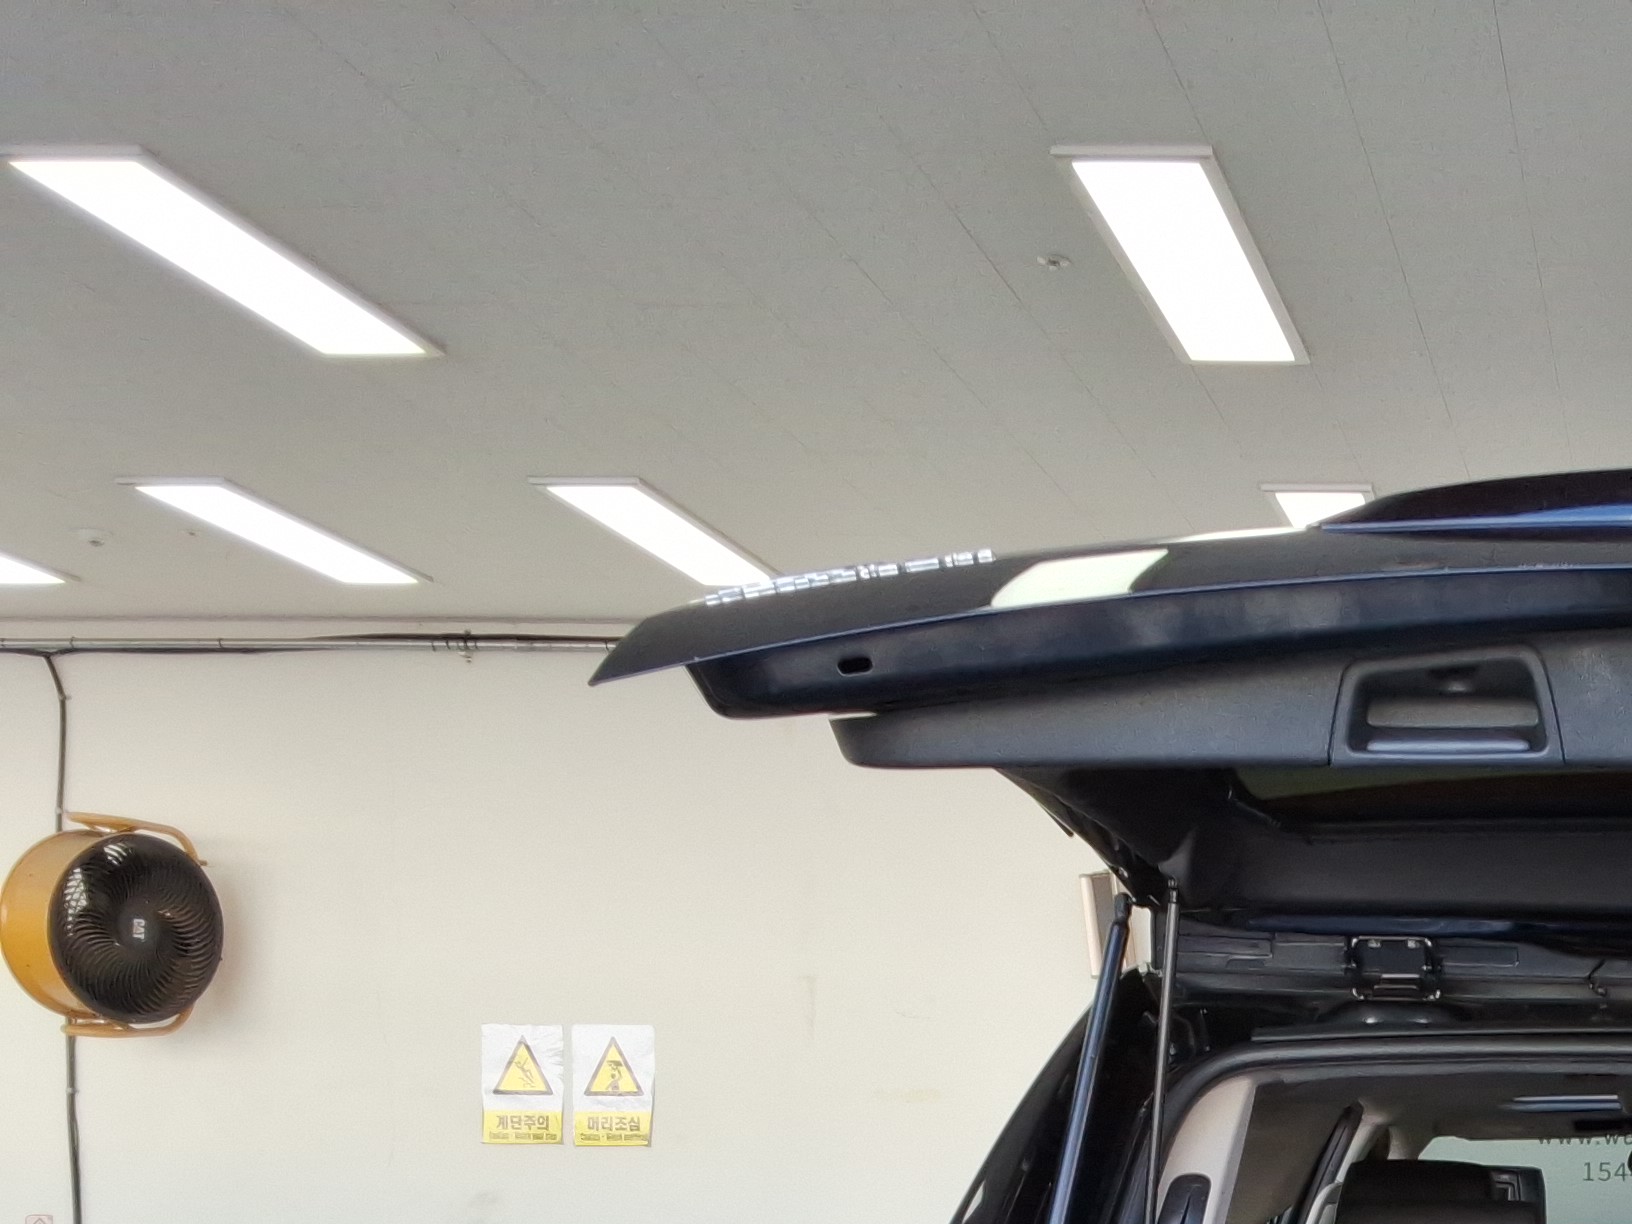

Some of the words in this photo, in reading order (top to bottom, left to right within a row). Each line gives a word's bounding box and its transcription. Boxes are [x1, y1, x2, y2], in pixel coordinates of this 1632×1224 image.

[133, 918, 145, 940] CAT
[496, 1114, 549, 1131] 계단주의
[587, 1116, 641, 1132] 머리조심
